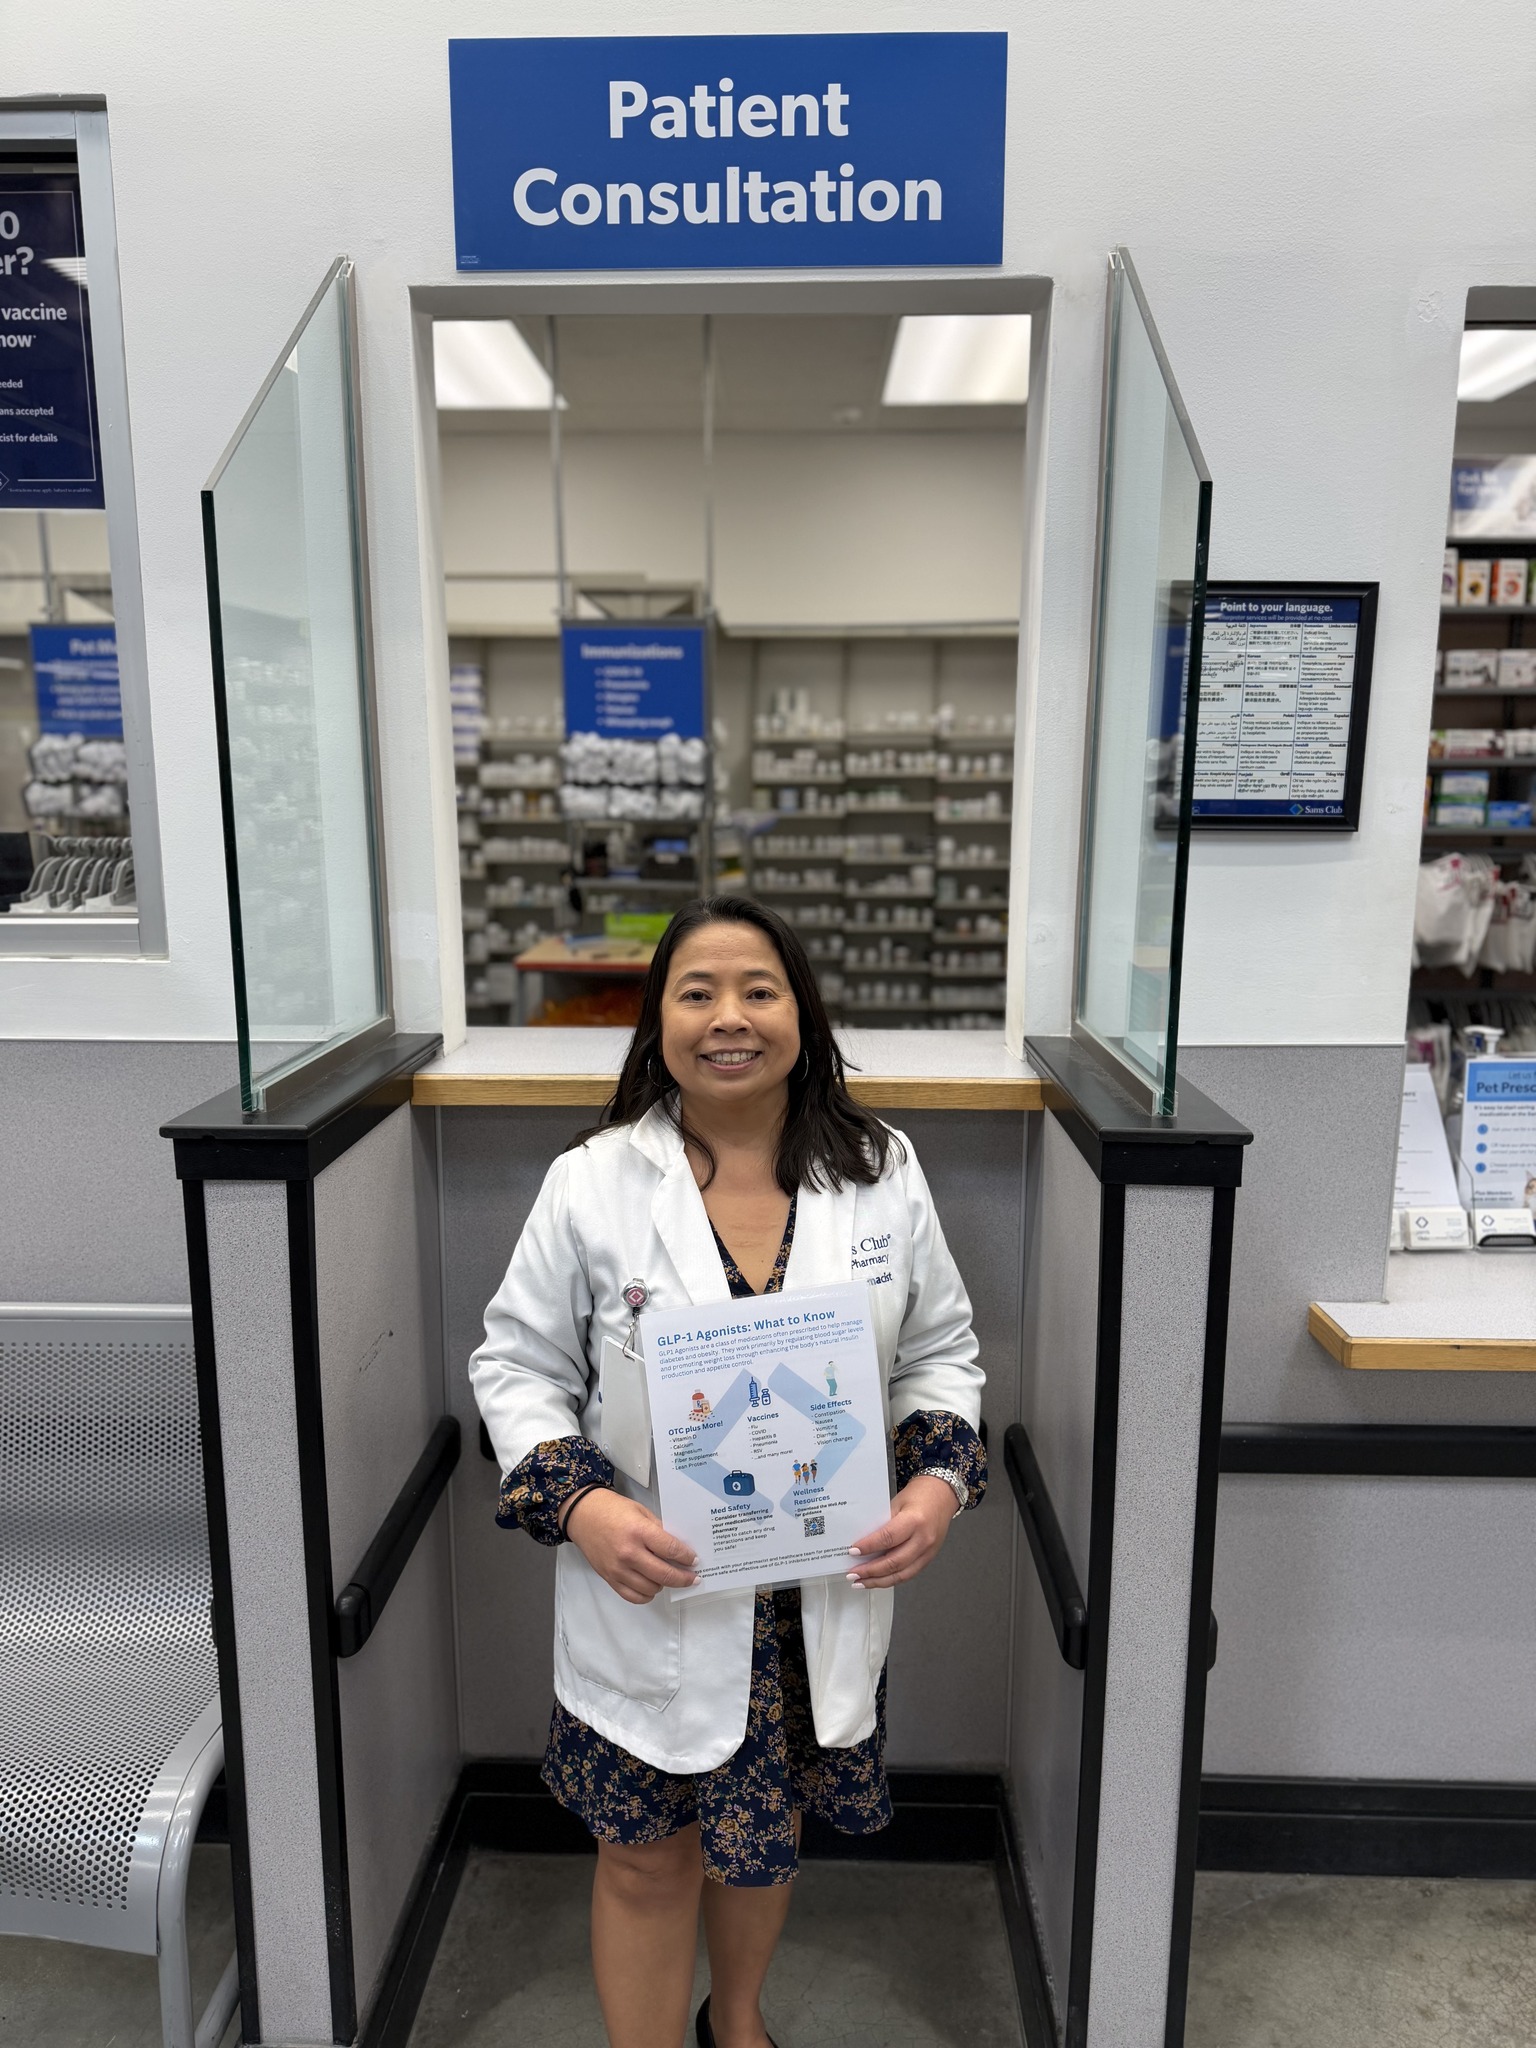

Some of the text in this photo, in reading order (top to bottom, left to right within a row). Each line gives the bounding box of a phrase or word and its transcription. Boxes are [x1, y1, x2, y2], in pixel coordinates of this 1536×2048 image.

[609, 77, 850, 139] Patient
[513, 163, 943, 227] Consultation
[1, 302, 68, 320] vaccine
[15, 406, 54, 417] accepted
[15, 433, 28, 442] for
[29, 433, 58, 442] details
[1220, 602, 1333, 614] Point to your language.
[1325, 805, 1342, 814] Club
[1477, 1081, 1498, 1094] Pet
[658, 1311, 835, 1346] GLP-1 Agonists: What to Know
[659, 1349, 674, 1357] GLP1
[675, 1346, 699, 1355] Agonists
[738, 1334, 772, 1343] medications
[789, 1325, 819, 1335] prescribed
[660, 1356, 684, 1364] diabetes
[751, 1341, 776, 1350] primarily
[785, 1335, 814, 1344] regulating
[673, 1361, 703, 1371] promoting
[736, 1351, 758, 1359] through
[760, 1346, 789, 1355] enhancing
[662, 1370, 693, 1380] production
[706, 1364, 730, 1372] appetite
[827, 1400, 852, 1408] Effects
[747, 1413, 779, 1422] Vaccines
[814, 1410, 846, 1418] Constipation
[668, 1420, 723, 1436] OTC plus More!
[816, 1424, 838, 1432] Vomiting
[673, 1442, 694, 1450] Calcium
[674, 1448, 702, 1456] Magnesium
[688, 1452, 718, 1461] supplement
[793, 1487, 824, 1496] Wellness
[794, 1495, 830, 1506] Resources
[728, 1504, 750, 1512] Safety
[738, 1508, 769, 1517] transferring
[725, 1517, 756, 1526] medications
[714, 1538, 744, 1546] interactions
